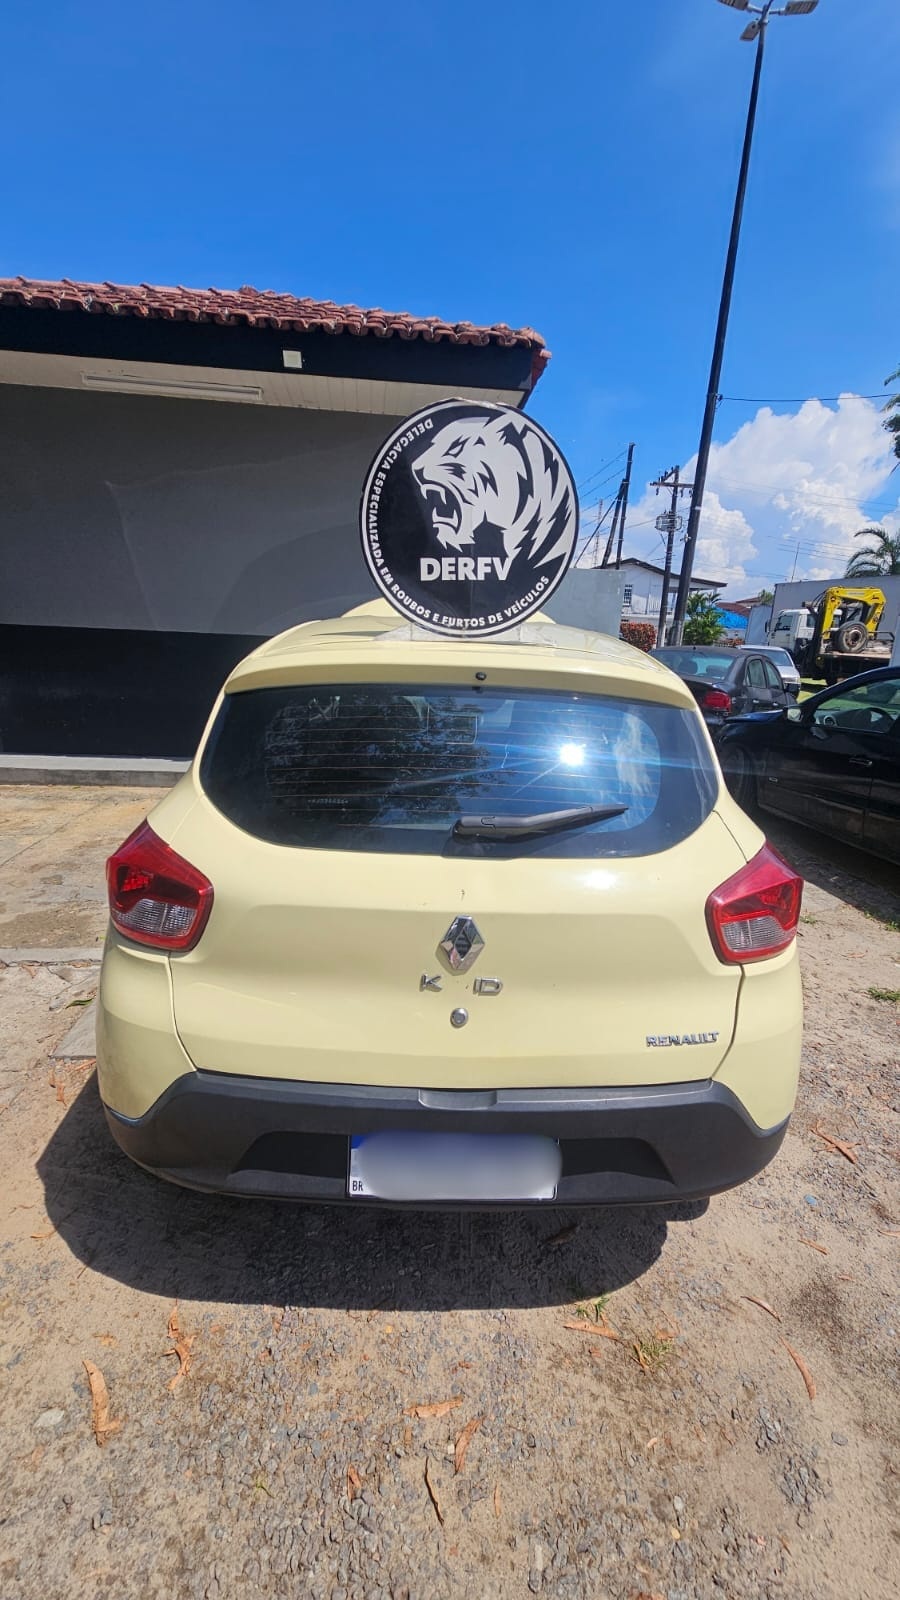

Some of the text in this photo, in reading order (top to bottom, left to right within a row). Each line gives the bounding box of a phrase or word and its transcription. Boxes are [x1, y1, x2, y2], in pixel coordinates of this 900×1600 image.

[369, 418, 550, 628] DELEGACIA ESPECIALIZADA EM ROUBOS E FURTOS DE VEÍCULOS
[420, 557, 512, 581] DERFV
[646, 1032, 720, 1047] RENAULT
[352, 1180, 364, 1191] BR
